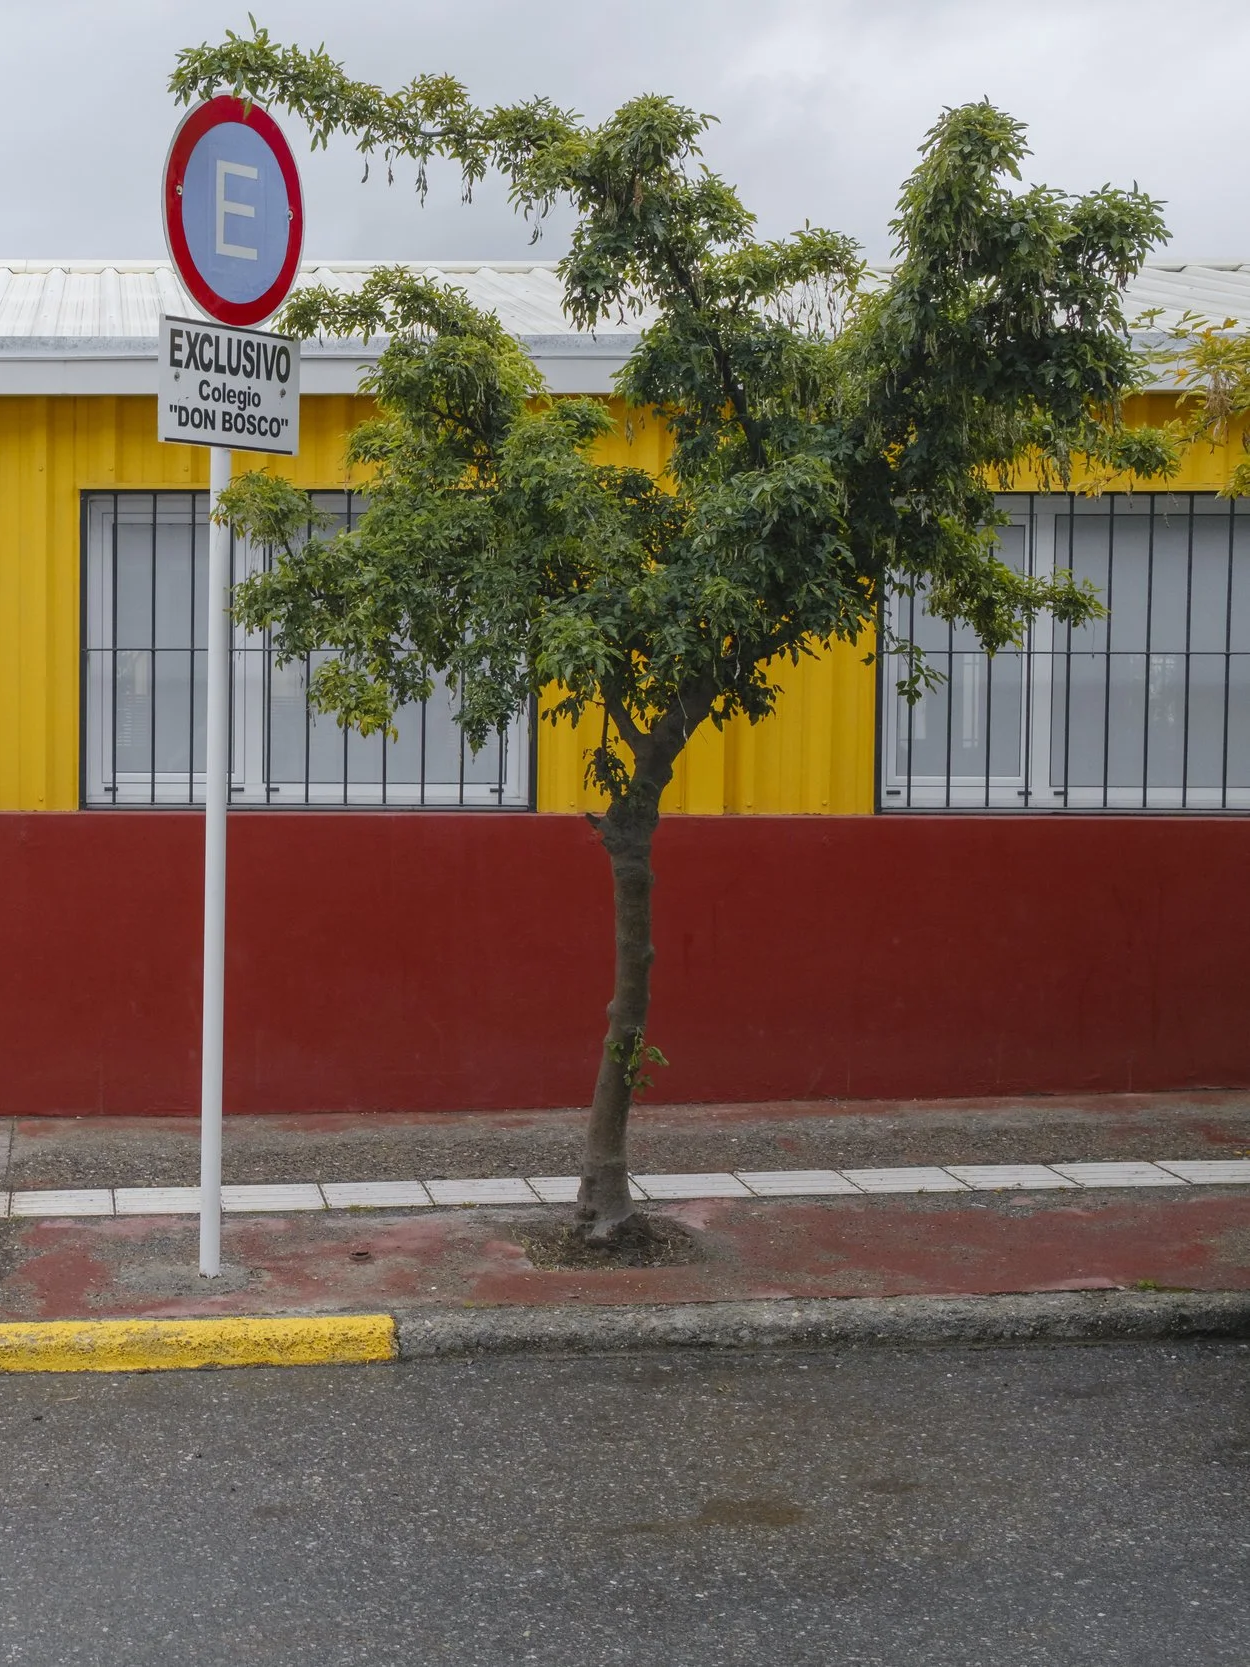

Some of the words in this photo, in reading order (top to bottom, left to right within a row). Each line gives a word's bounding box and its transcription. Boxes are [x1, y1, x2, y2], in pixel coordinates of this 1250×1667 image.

[216, 159, 258, 260] E
[169, 327, 291, 383] EXCLUSIVO
[199, 379, 262, 412] Colegio
[169, 404, 216, 431] "DON
[221, 412, 289, 438] BOSCO"
